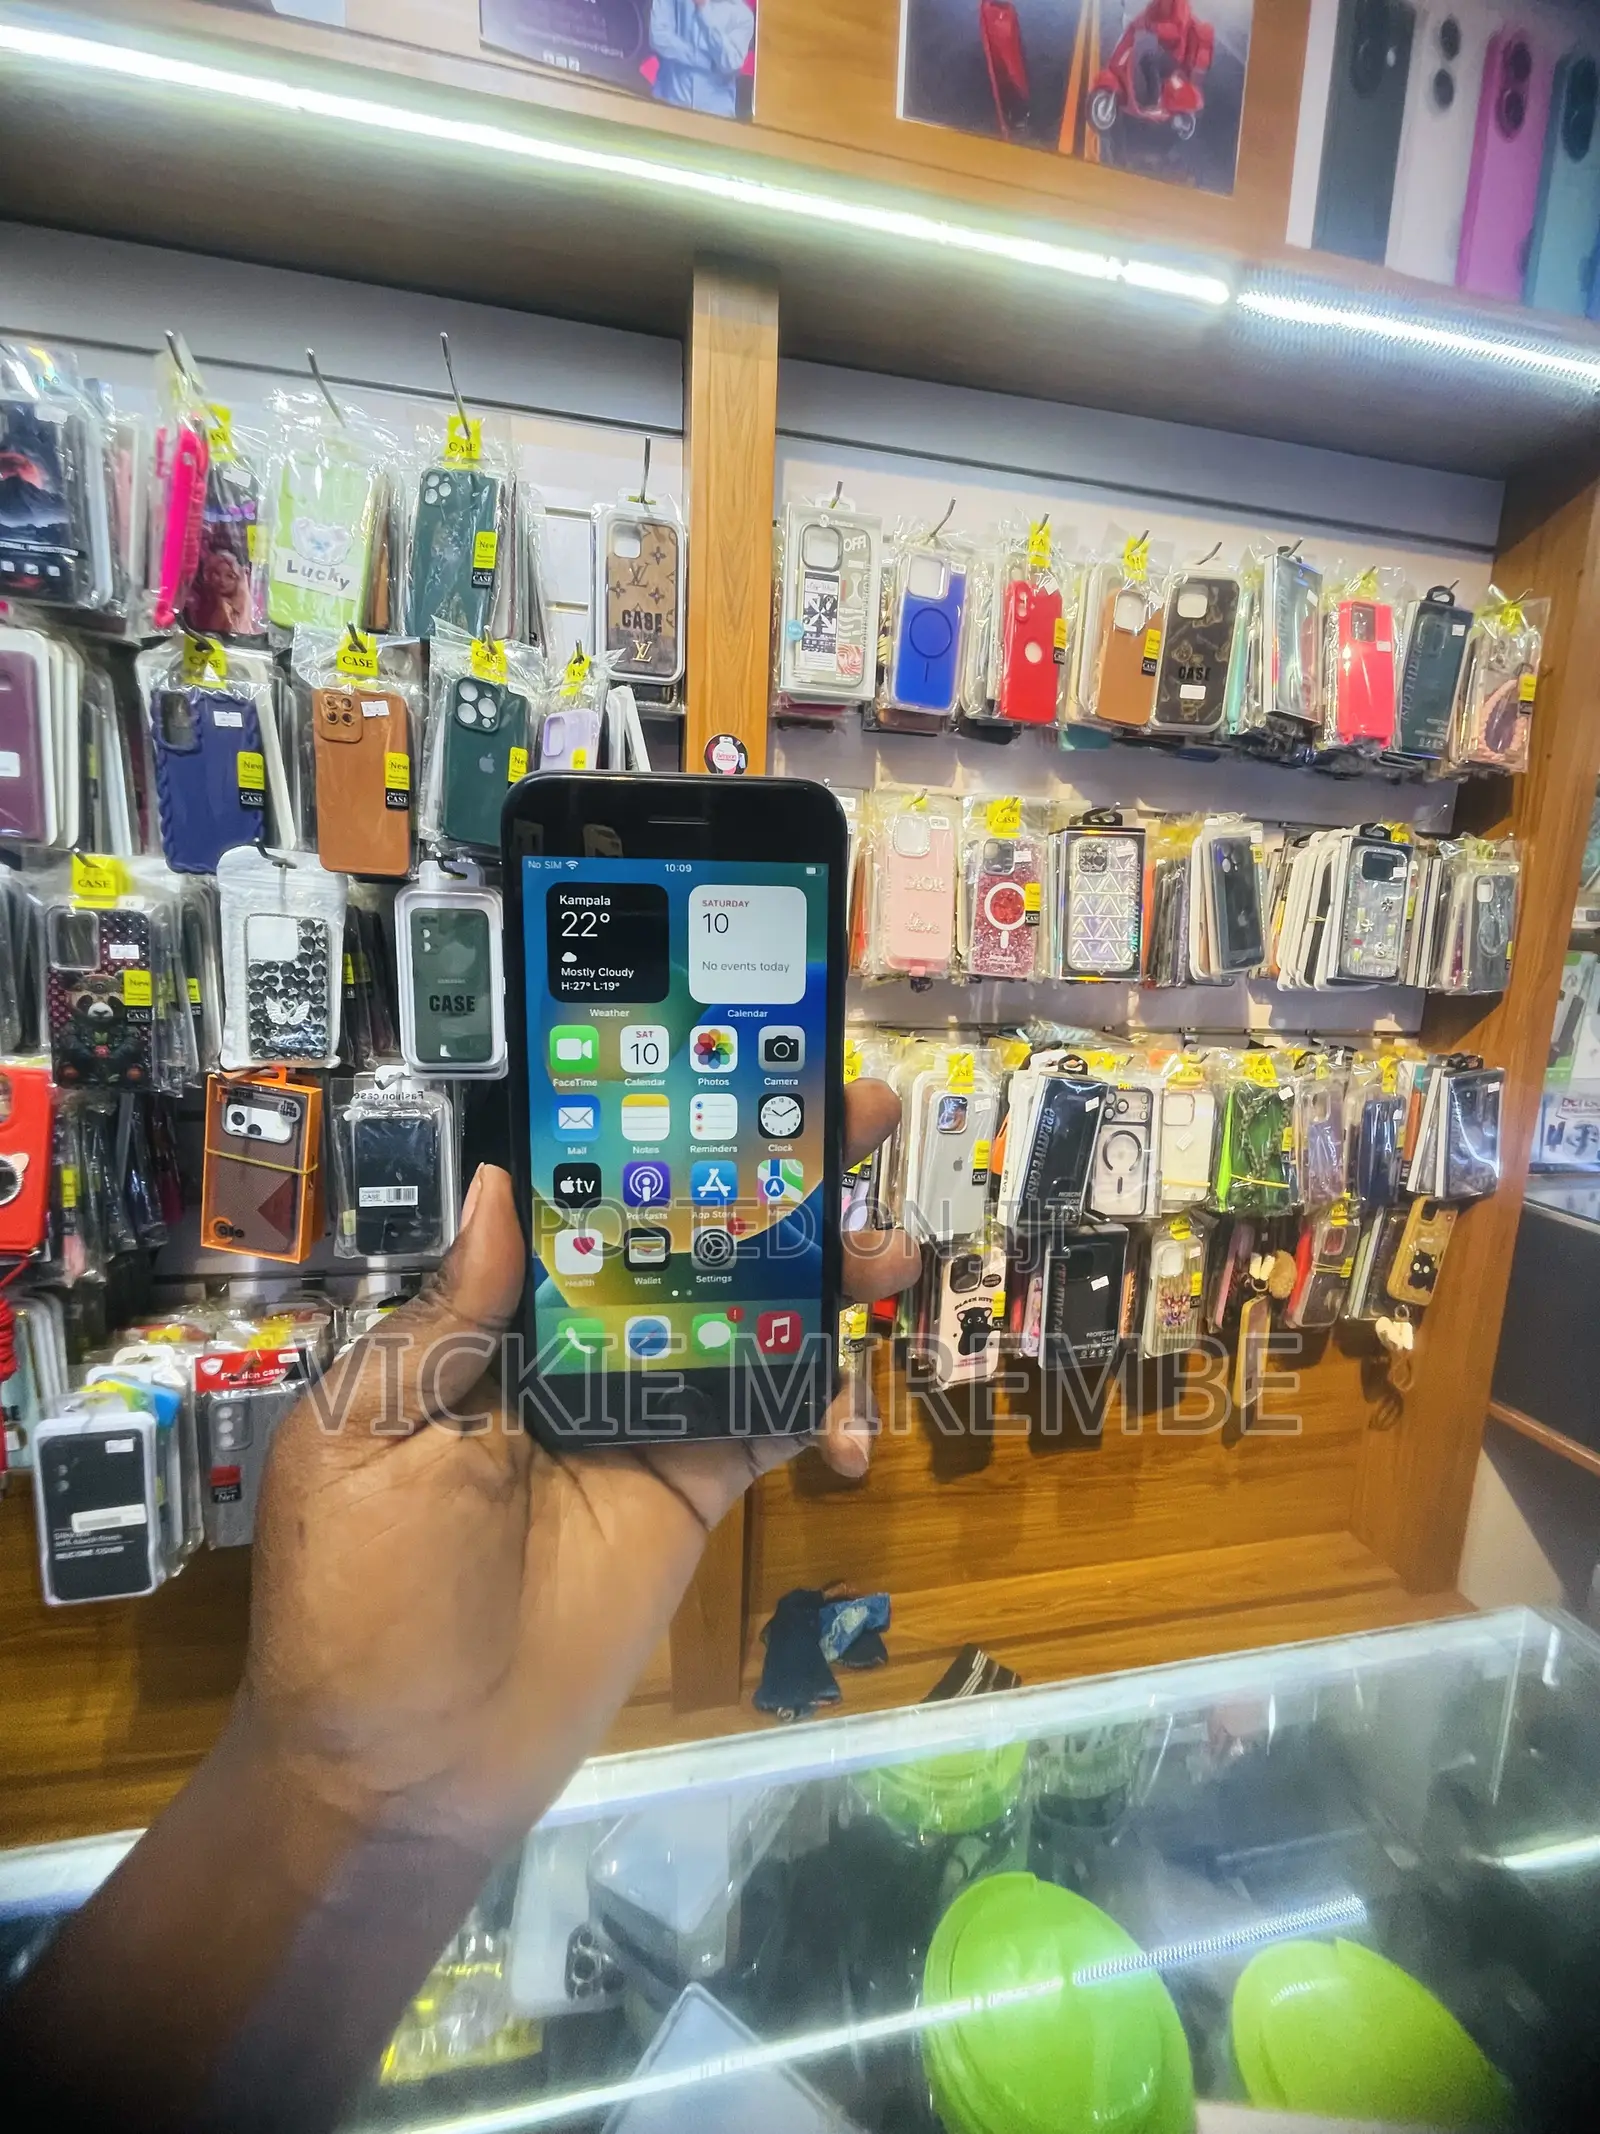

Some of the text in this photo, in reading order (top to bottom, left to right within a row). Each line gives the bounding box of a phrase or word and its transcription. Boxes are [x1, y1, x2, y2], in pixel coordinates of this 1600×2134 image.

[286, 559, 350, 591] Lucky
[622, 609, 663, 633] CASE
[342, 655, 375, 669] CASE
[243, 760, 263, 770] New
[390, 761, 409, 770] New
[240, 794, 264, 803] CASE
[386, 795, 408, 803] CASE
[528, 860, 562, 870] No SIM
[664, 863, 692, 873] 10:09
[78, 877, 112, 889] CASE
[559, 894, 611, 907] Kampala
[702, 899, 750, 908] SATURDAY
[561, 912, 611, 938] 22°
[702, 912, 729, 934] 10
[702, 961, 790, 974] No events today
[561, 967, 634, 979] Mostly Cloudy
[561, 981, 620, 991] H:27° L:19°
[429, 994, 476, 1013] CASE
[127, 1011, 151, 1020] CASE
[589, 1008, 630, 1018] Weather
[727, 1009, 768, 1018] Calendar
[636, 1030, 653, 1039] SAT
[630, 1043, 660, 1065] 10
[553, 1078, 598, 1088] FaceTime
[624, 1078, 666, 1087] Calendar
[698, 1077, 730, 1087] Photos
[764, 1078, 799, 1087] Camera
[567, 1146, 587, 1155] Mail
[632, 1145, 660, 1155] Notes
[690, 1144, 738, 1154] Reminders
[768, 1143, 793, 1152] Clock
[575, 1178, 595, 1193] tv
[626, 1211, 668, 1221] Podcasts
[691, 1210, 737, 1220] App Store
[565, 1278, 595, 1288] Health
[634, 1276, 662, 1286] Wallet
[695, 1274, 733, 1285] Settings
[262, 1367, 287, 1377] case
